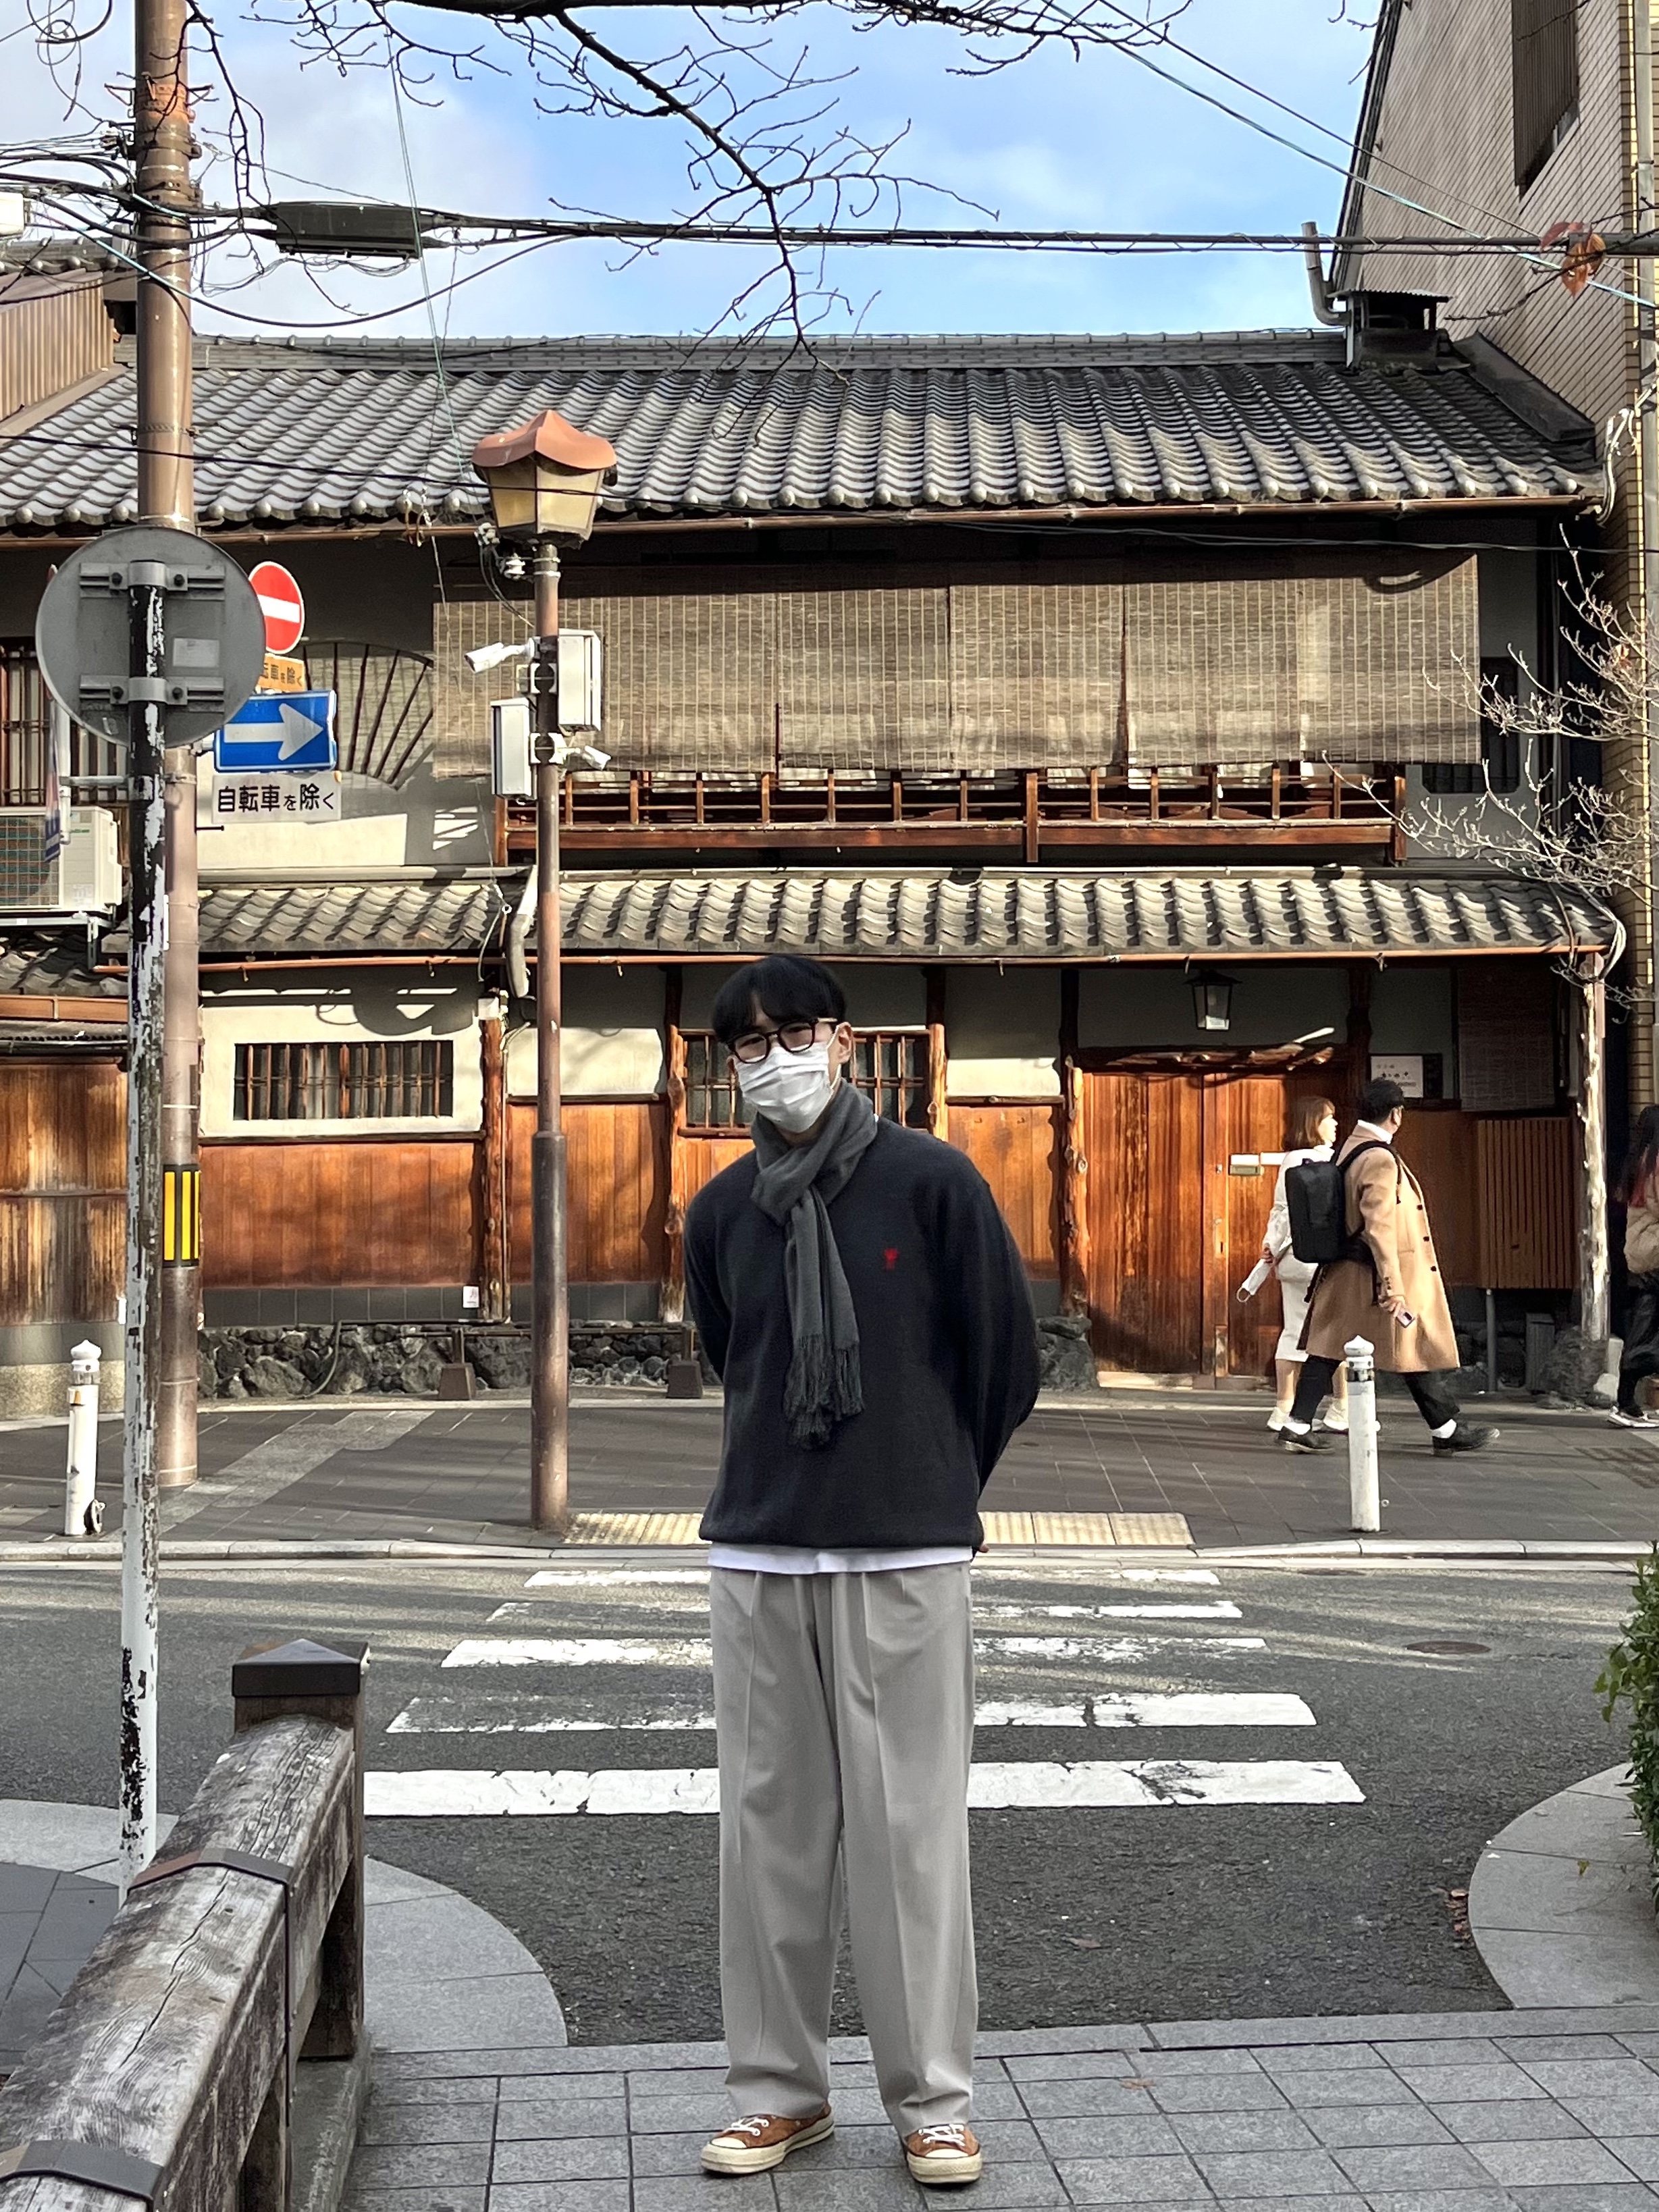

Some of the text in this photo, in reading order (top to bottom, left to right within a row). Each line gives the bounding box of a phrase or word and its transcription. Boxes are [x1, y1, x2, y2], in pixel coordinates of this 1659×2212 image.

[218, 783, 334, 812] 自転車を除く
